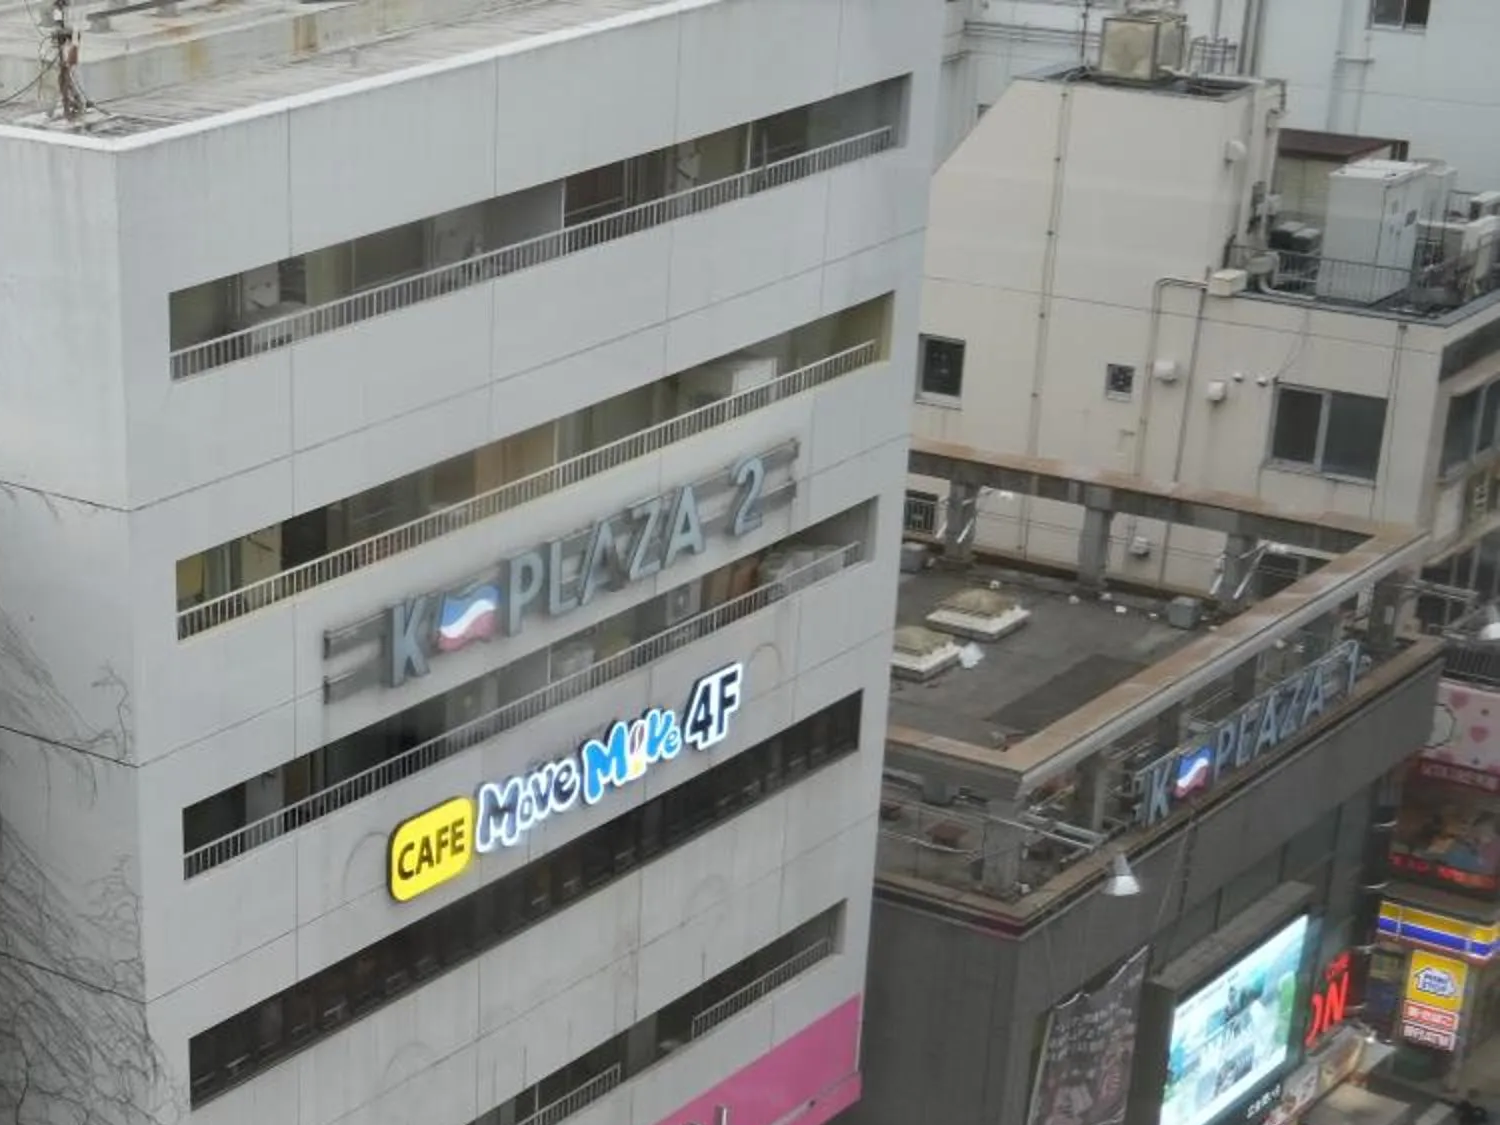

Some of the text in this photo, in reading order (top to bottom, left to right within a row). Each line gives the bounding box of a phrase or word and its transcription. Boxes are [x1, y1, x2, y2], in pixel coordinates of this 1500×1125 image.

[385, 456, 766, 688] K PLAZA 2
[396, 815, 468, 882] CAFE
[684, 661, 743, 751] 4F
[1212, 664, 1326, 784] PLAZA
